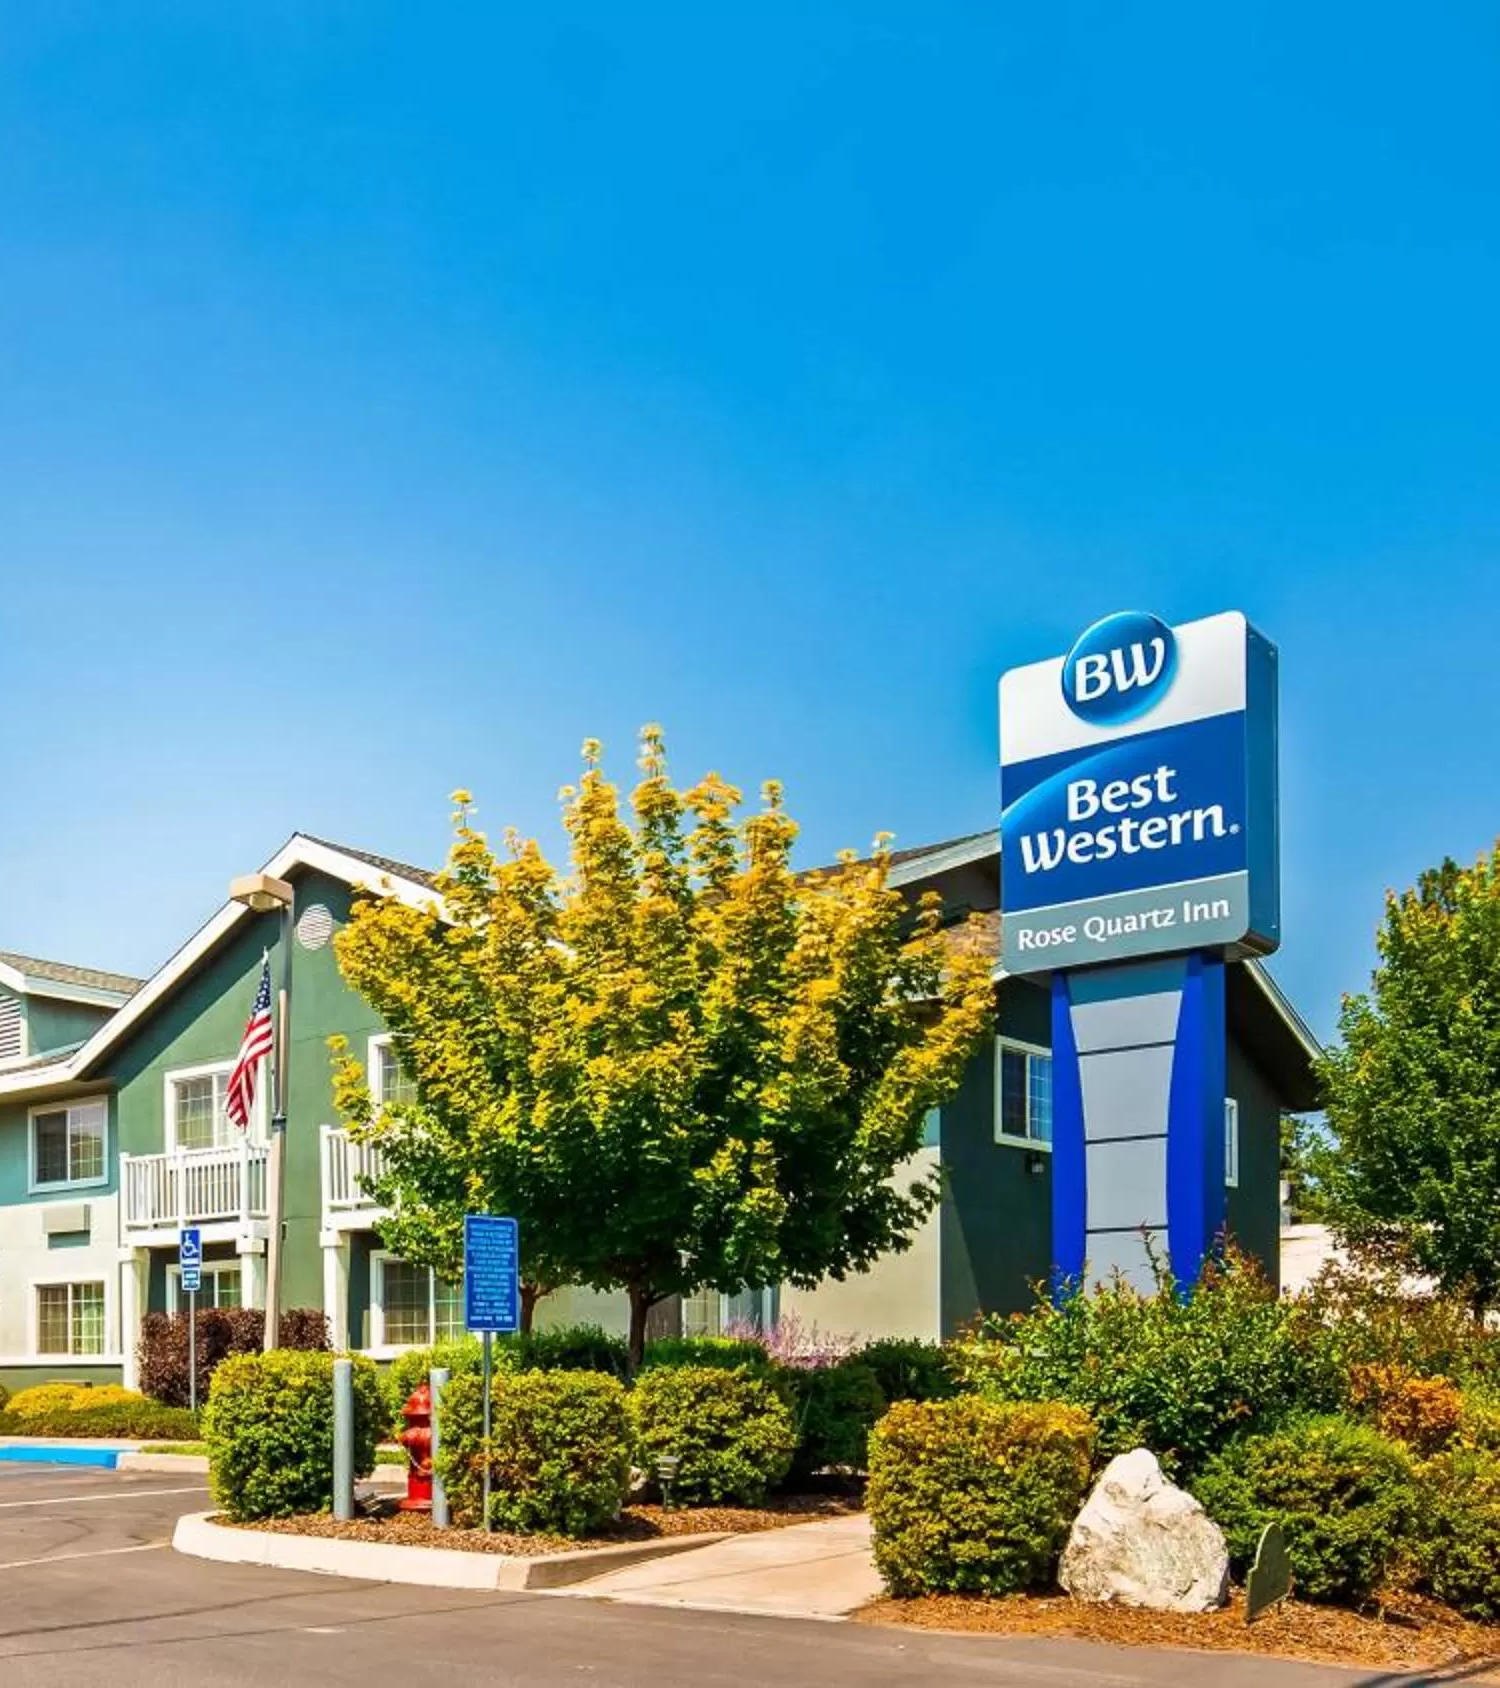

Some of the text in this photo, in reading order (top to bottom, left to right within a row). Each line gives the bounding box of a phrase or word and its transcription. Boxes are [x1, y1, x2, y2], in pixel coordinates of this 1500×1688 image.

[1075, 637, 1166, 702] BW
[1067, 765, 1177, 822] Best
[1018, 899, 1230, 951] Rose Quartz Inn
